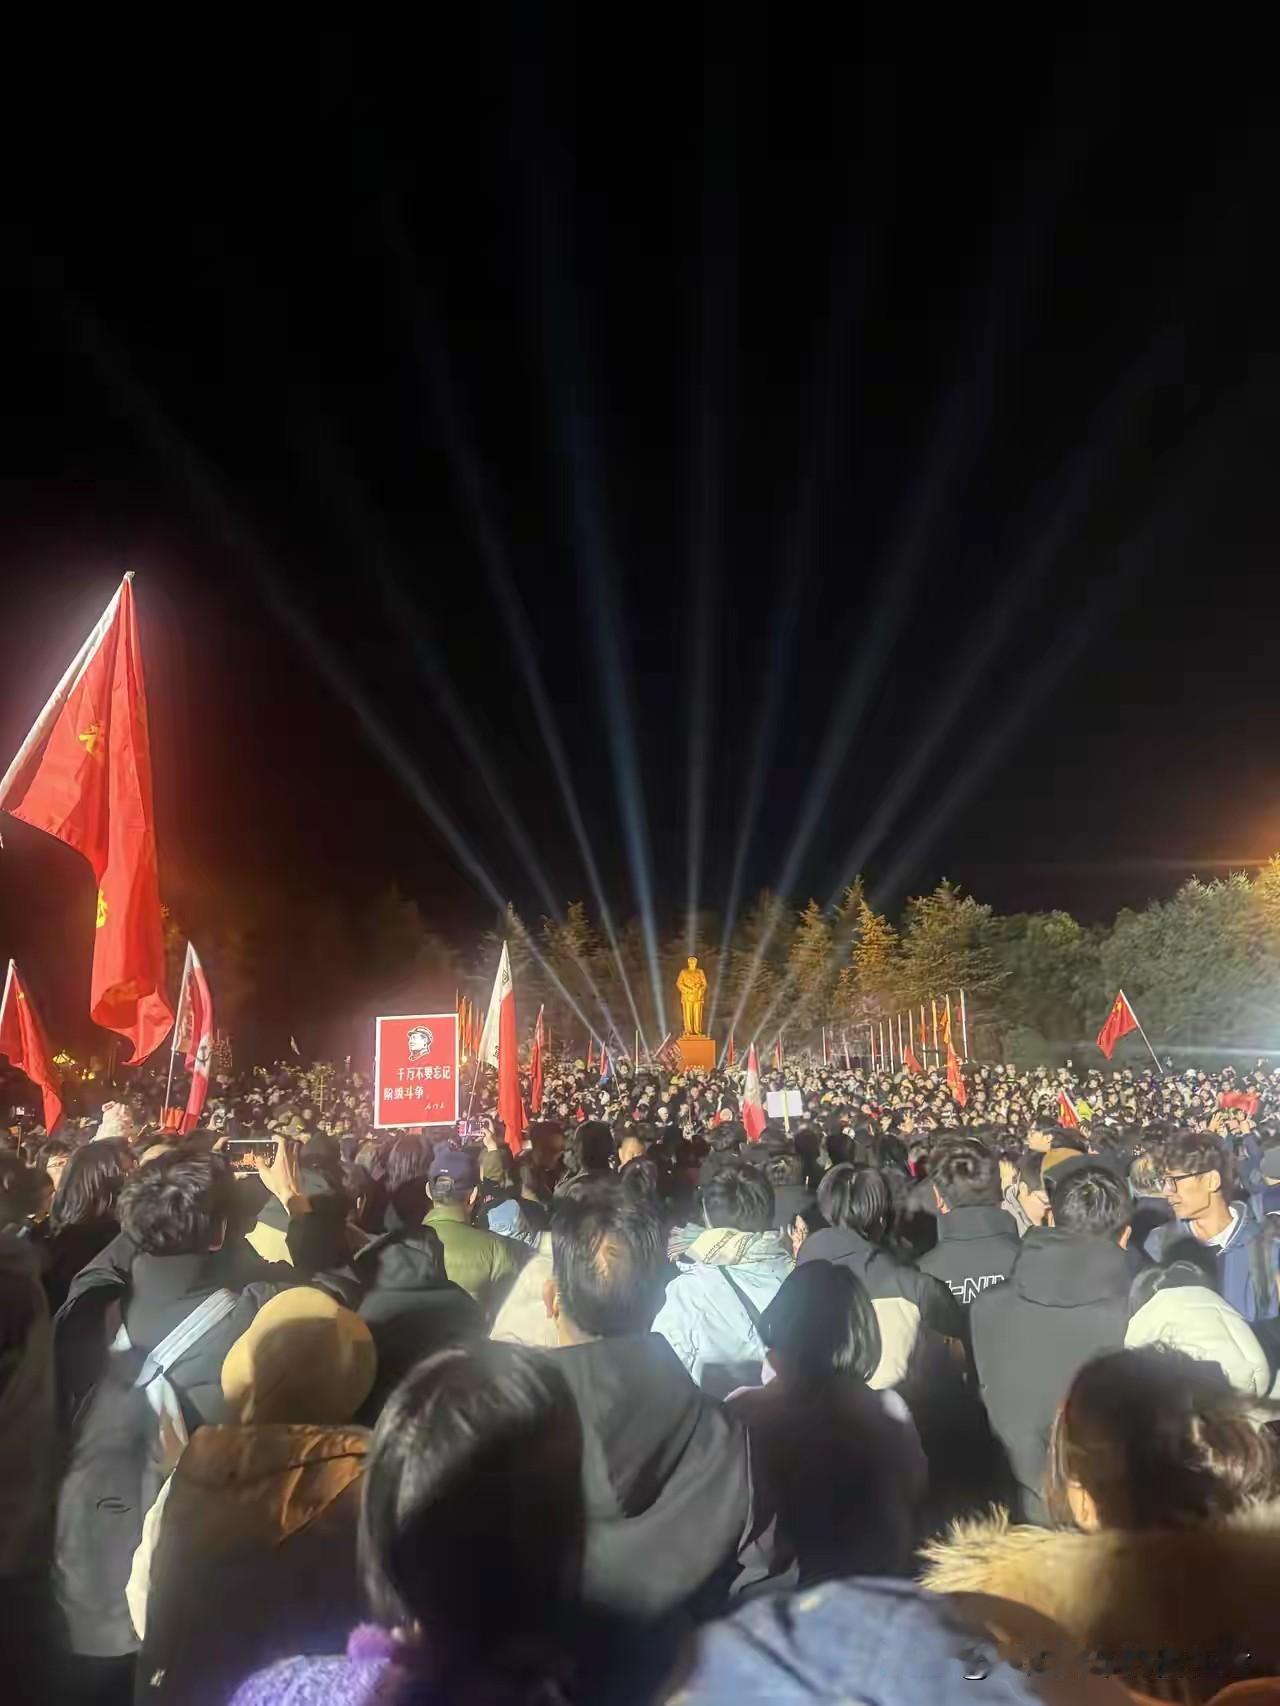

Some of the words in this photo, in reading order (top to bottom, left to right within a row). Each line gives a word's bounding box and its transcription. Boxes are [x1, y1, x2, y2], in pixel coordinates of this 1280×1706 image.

[397, 1065, 451, 1081] 千万不要忘记
